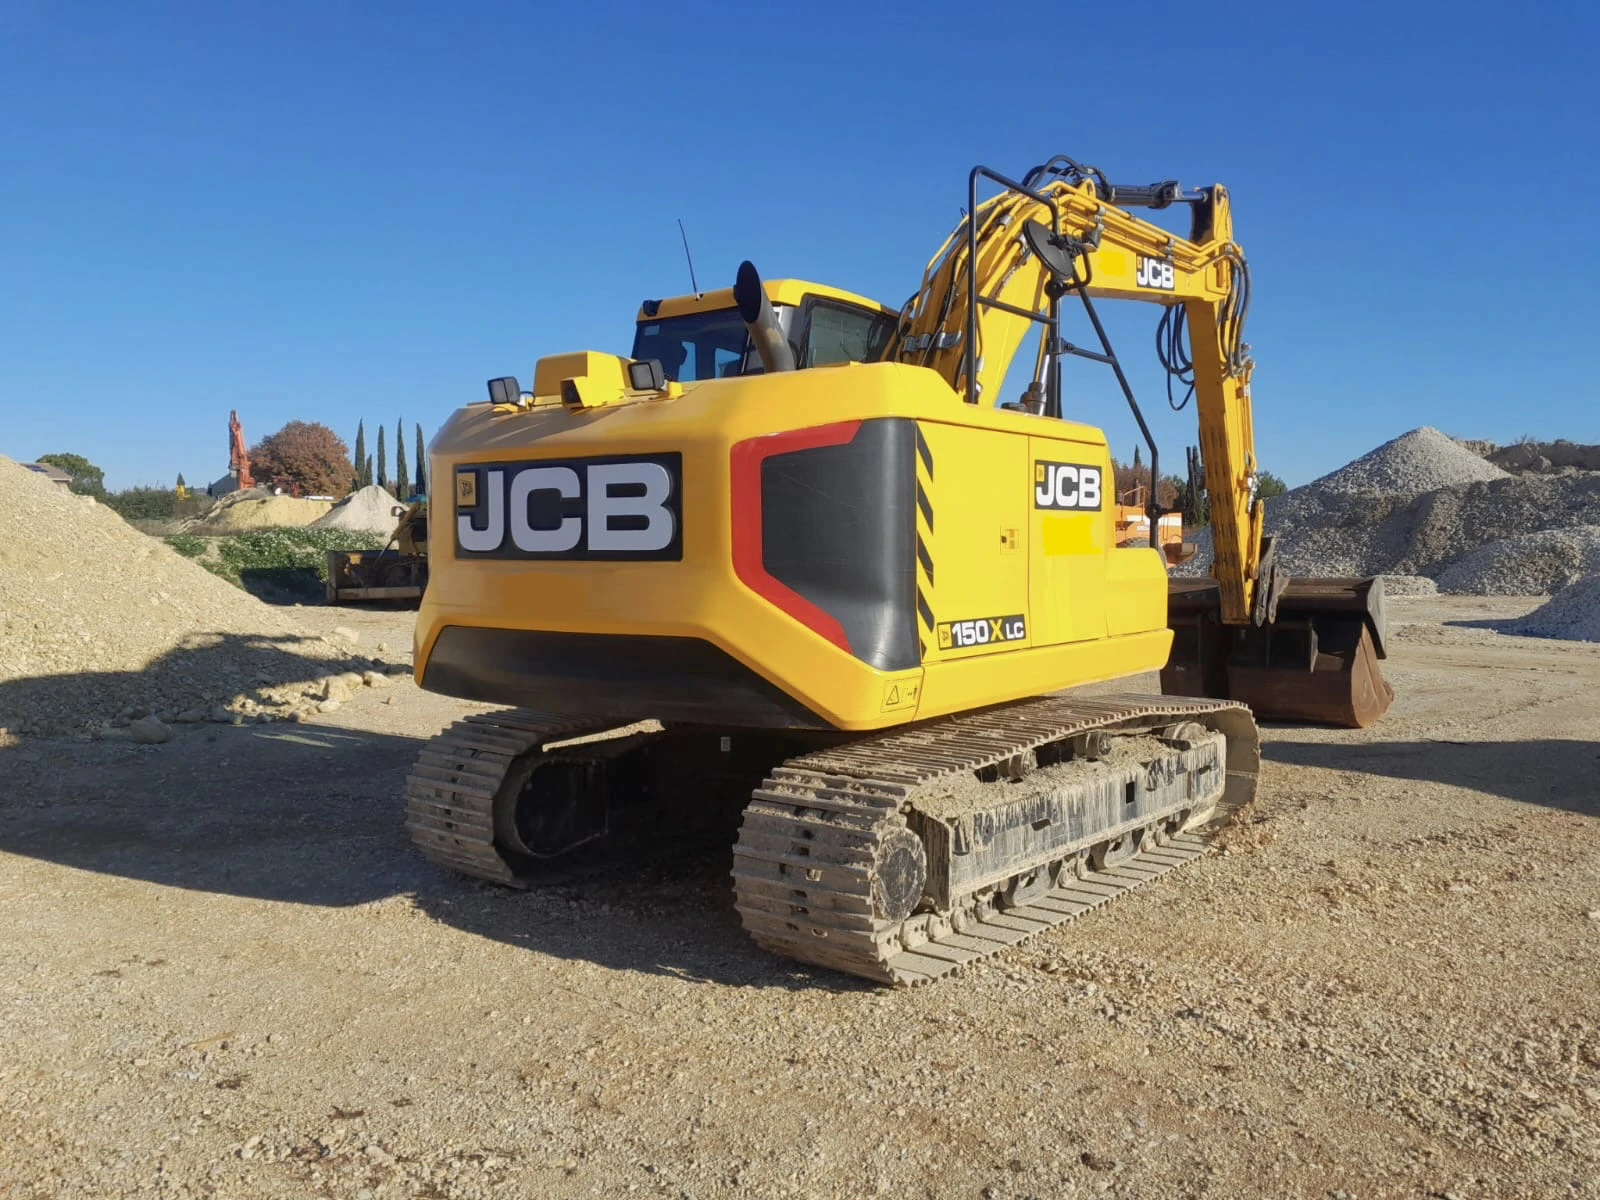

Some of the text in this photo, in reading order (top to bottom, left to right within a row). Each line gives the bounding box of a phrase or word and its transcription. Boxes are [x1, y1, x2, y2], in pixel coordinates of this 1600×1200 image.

[1137, 256, 1174, 288] JCB
[457, 462, 674, 551] JCB
[1036, 465, 1100, 507] JCB
